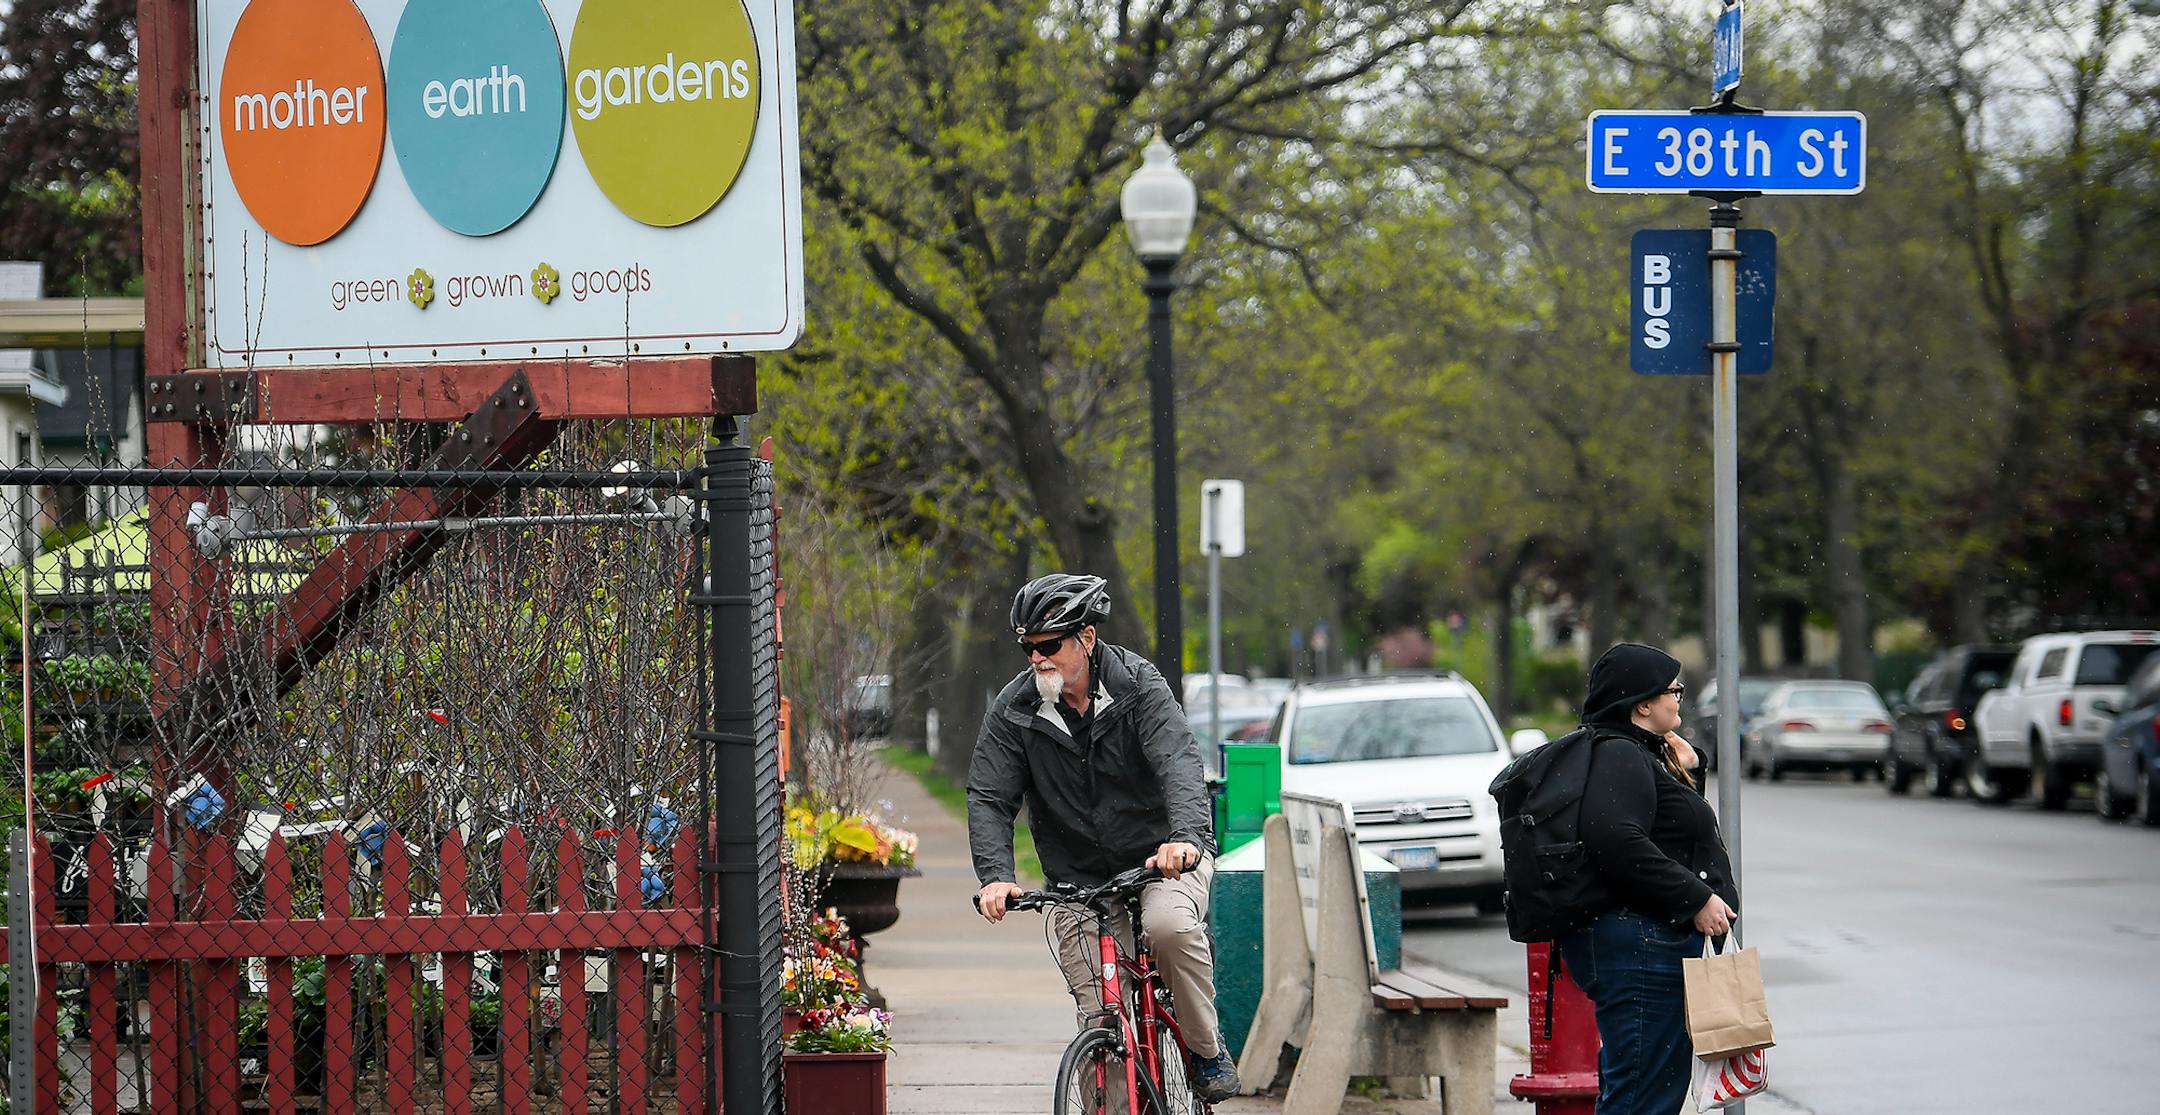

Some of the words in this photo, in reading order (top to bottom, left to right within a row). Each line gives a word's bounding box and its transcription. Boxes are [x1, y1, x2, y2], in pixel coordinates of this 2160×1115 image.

[233, 79, 368, 132] mother
[421, 64, 527, 119] earth
[574, 52, 751, 122] gardens
[1604, 127, 1629, 176] E
[1654, 127, 1772, 178] 38th
[1796, 128, 1849, 178] St
[330, 274, 400, 311] green
[446, 270, 524, 307] grown
[571, 262, 652, 303] goods
[1642, 253, 1672, 350] BUS
